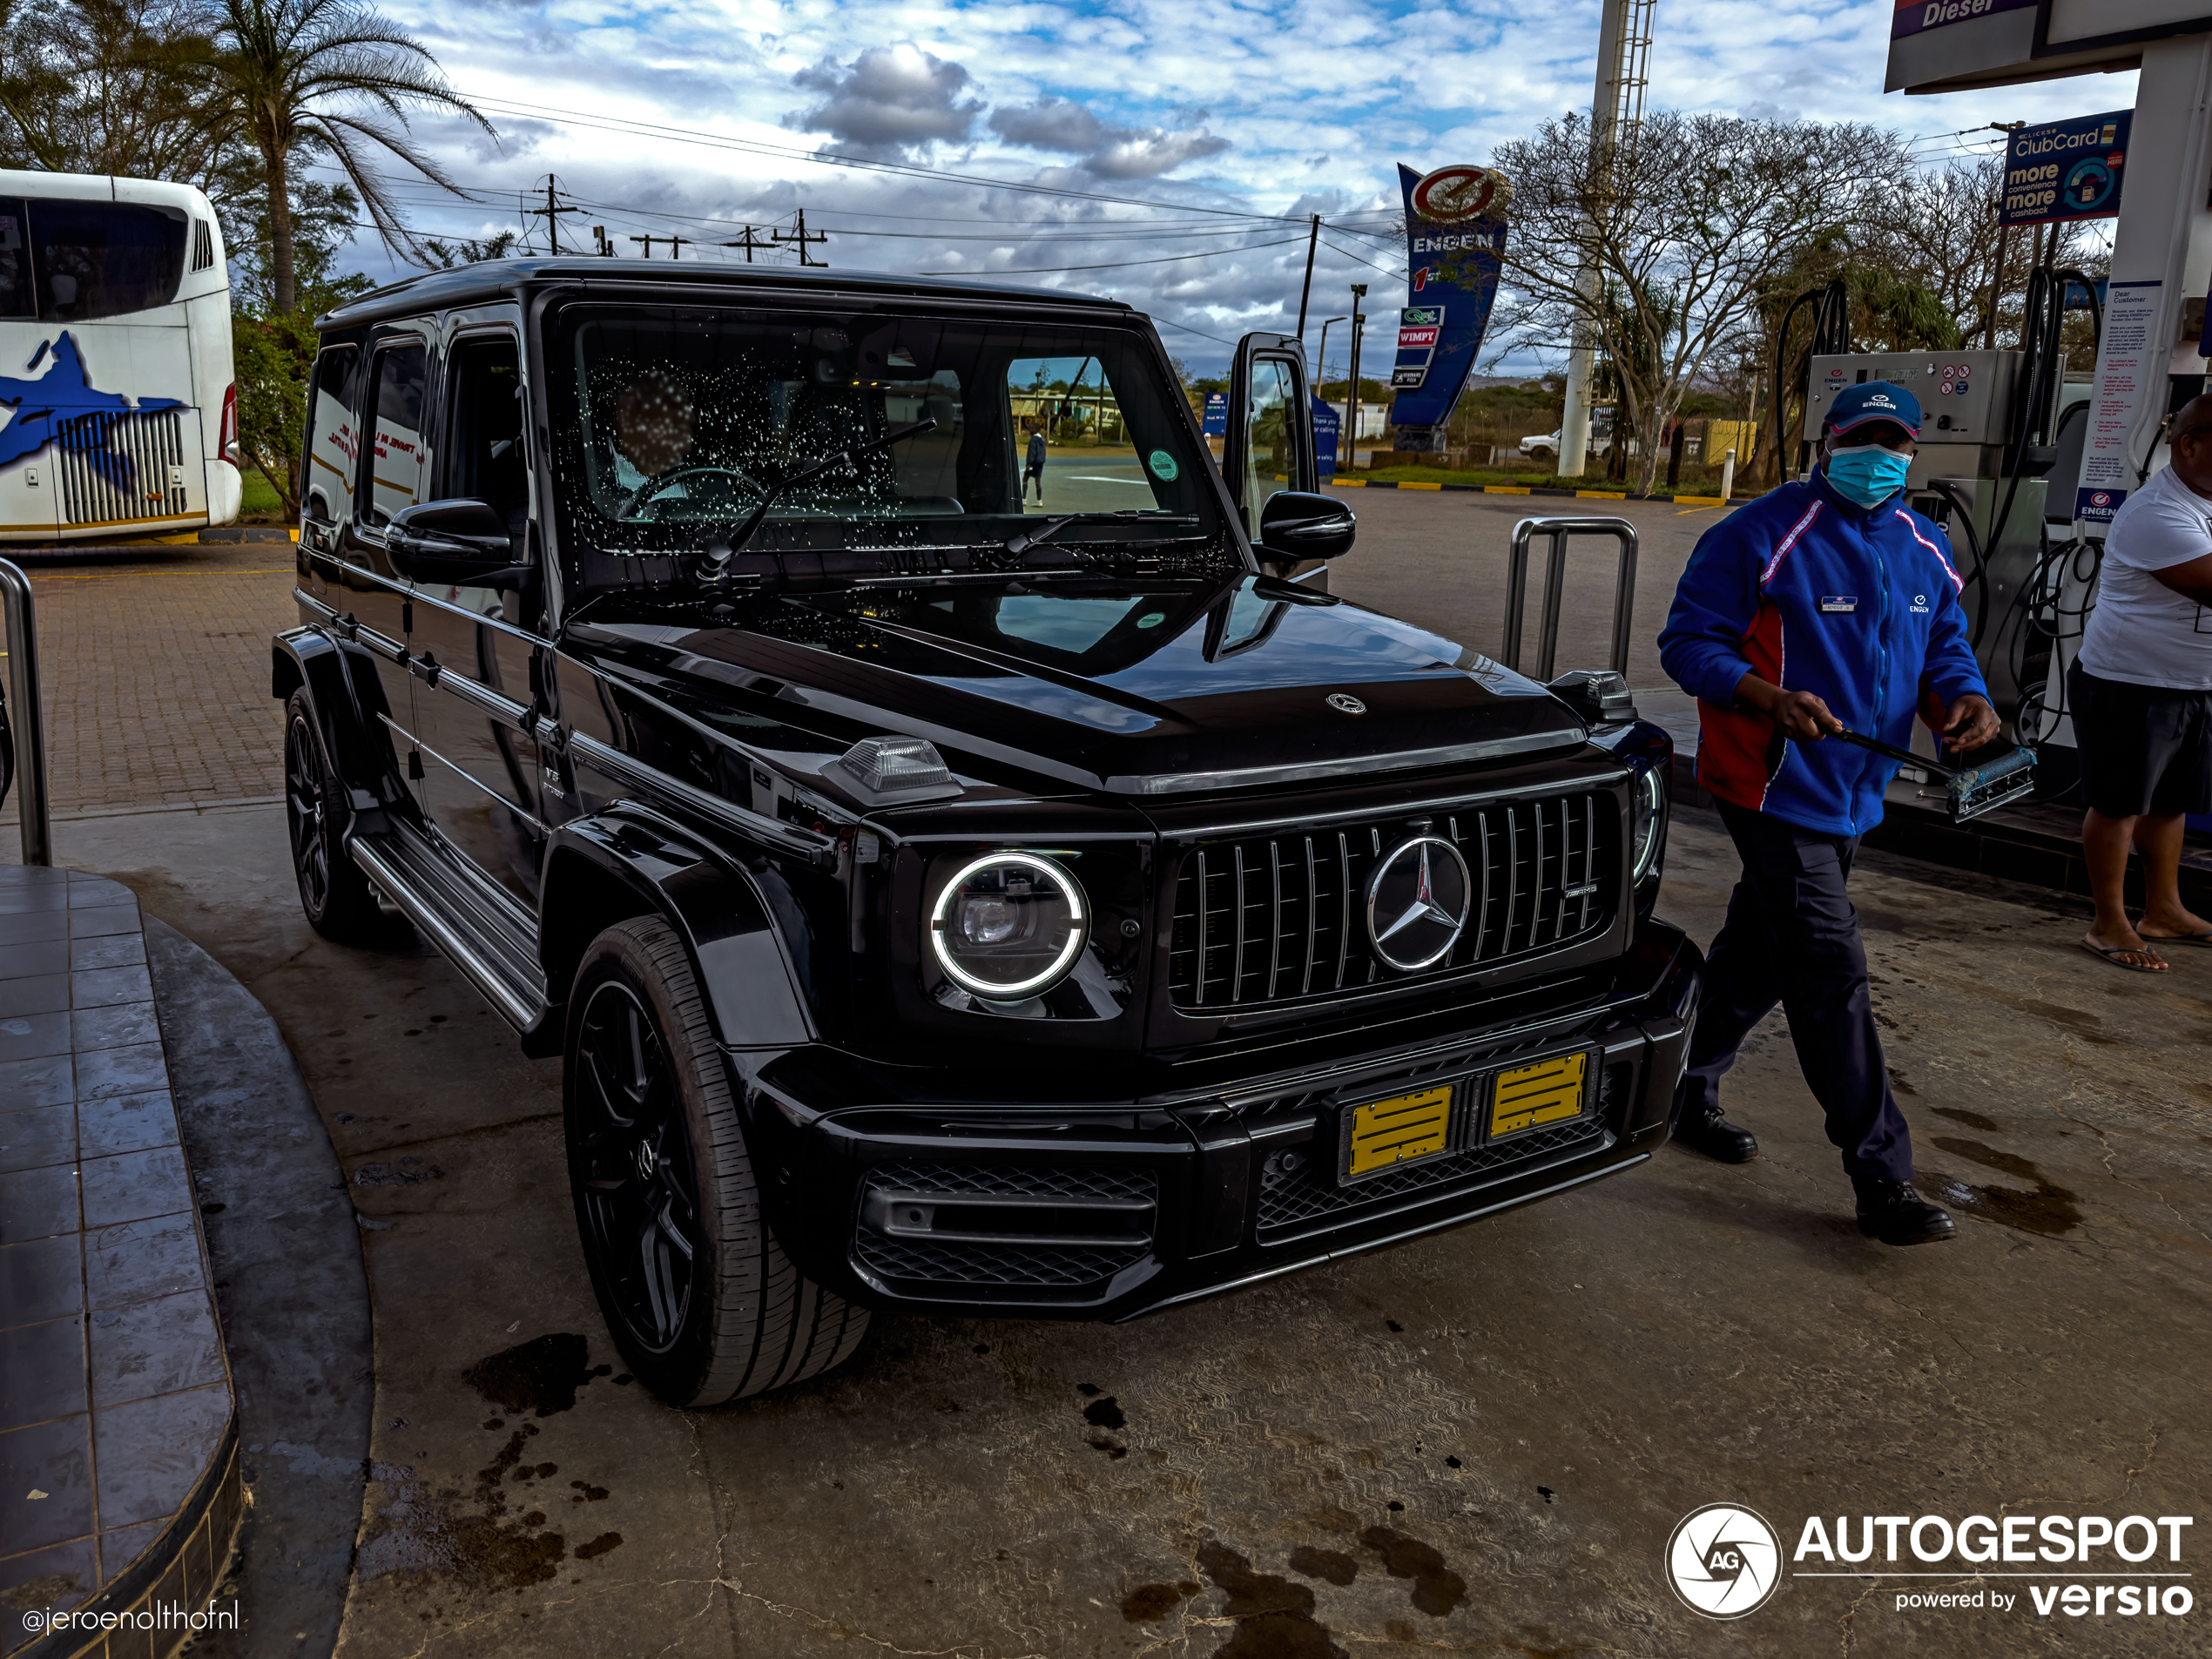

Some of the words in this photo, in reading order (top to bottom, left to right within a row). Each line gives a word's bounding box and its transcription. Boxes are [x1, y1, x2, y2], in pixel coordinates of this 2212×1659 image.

[2022, 130, 2051, 139] CLICKS
[2016, 128, 2098, 157] ClubCard
[2009, 164, 2059, 185] more
[2008, 180, 2057, 194] convenience
[2006, 190, 2056, 210] more
[2010, 206, 2049, 218] cashback
[1413, 233, 1494, 253] ENGEN
[1400, 332, 1434, 342] WIMPY
[1862, 401, 1897, 410] ENGEN
[2081, 507, 2116, 516] ENGEN
[545, 767, 560, 782] V8
[1573, 886, 1597, 896] AMG
